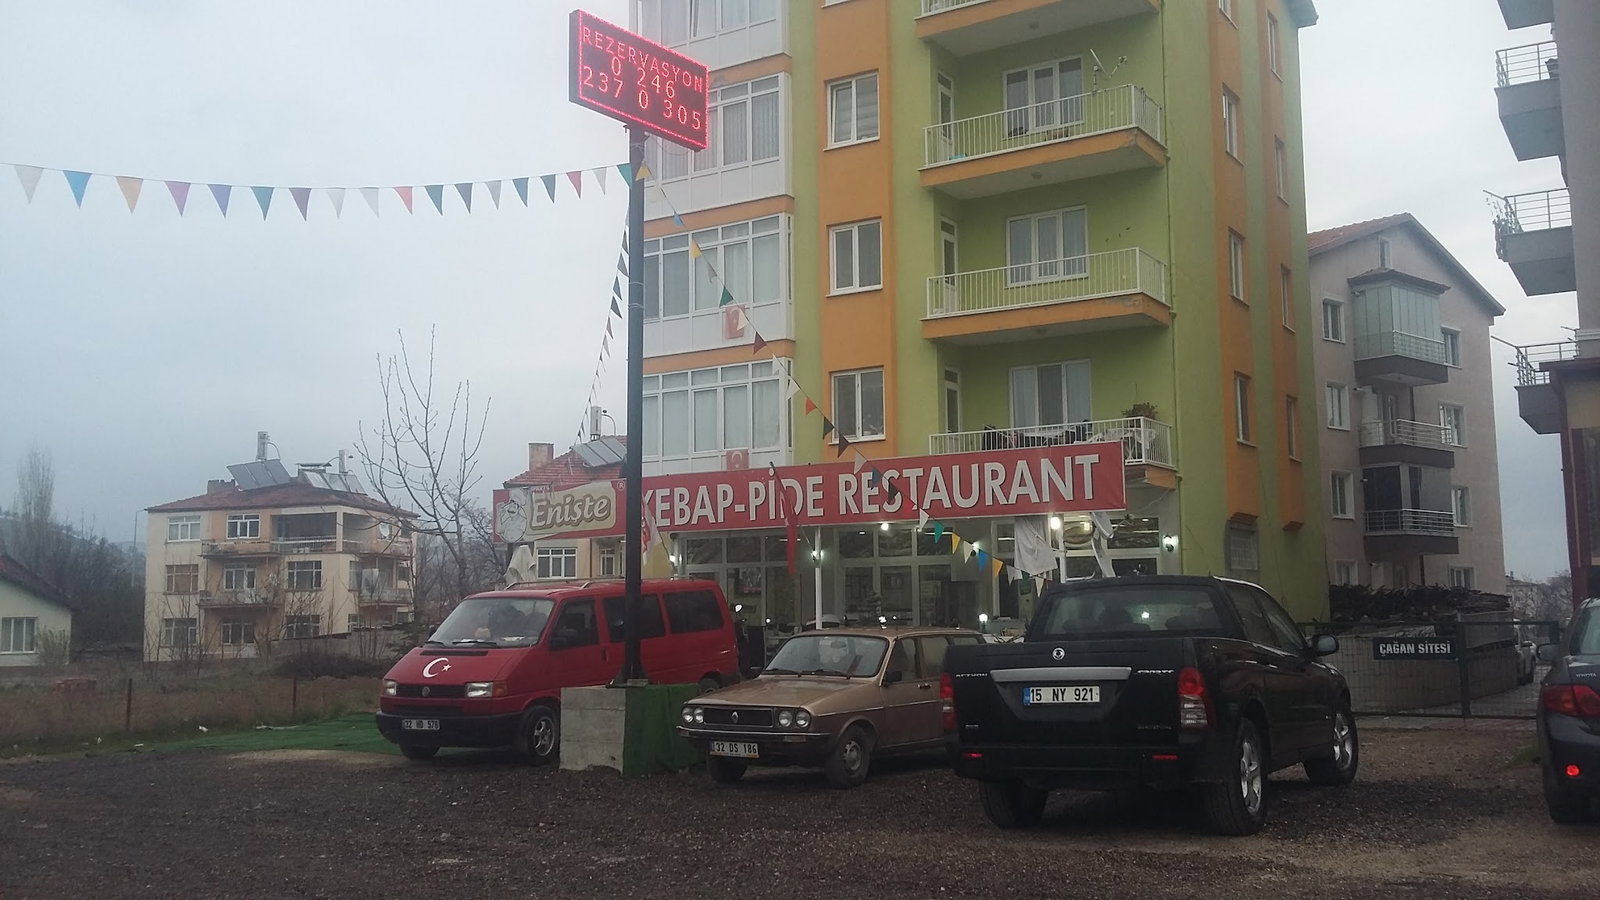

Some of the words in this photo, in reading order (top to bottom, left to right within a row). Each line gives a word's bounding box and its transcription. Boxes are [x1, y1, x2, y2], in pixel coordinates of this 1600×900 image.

[583, 26, 703, 92] REZERVASYON
[611, 56, 621, 76] 0
[637, 67, 675, 98] 246
[583, 66, 624, 98] 237
[638, 89, 649, 109] 0
[663, 99, 701, 130] 305
[838, 454, 1099, 516] RESTAURANT
[531, 495, 610, 528] Enişte
[1379, 640, 1415, 657] ÇAĞAN
[1418, 640, 1451, 654] SİTESİ
[1031, 688, 1042, 702] 15
[1052, 688, 1066, 702] NY
[1074, 687, 1093, 701] 921
[715, 742, 725, 752] 32
[729, 743, 738, 753] DS
[743, 743, 756, 754] 186
